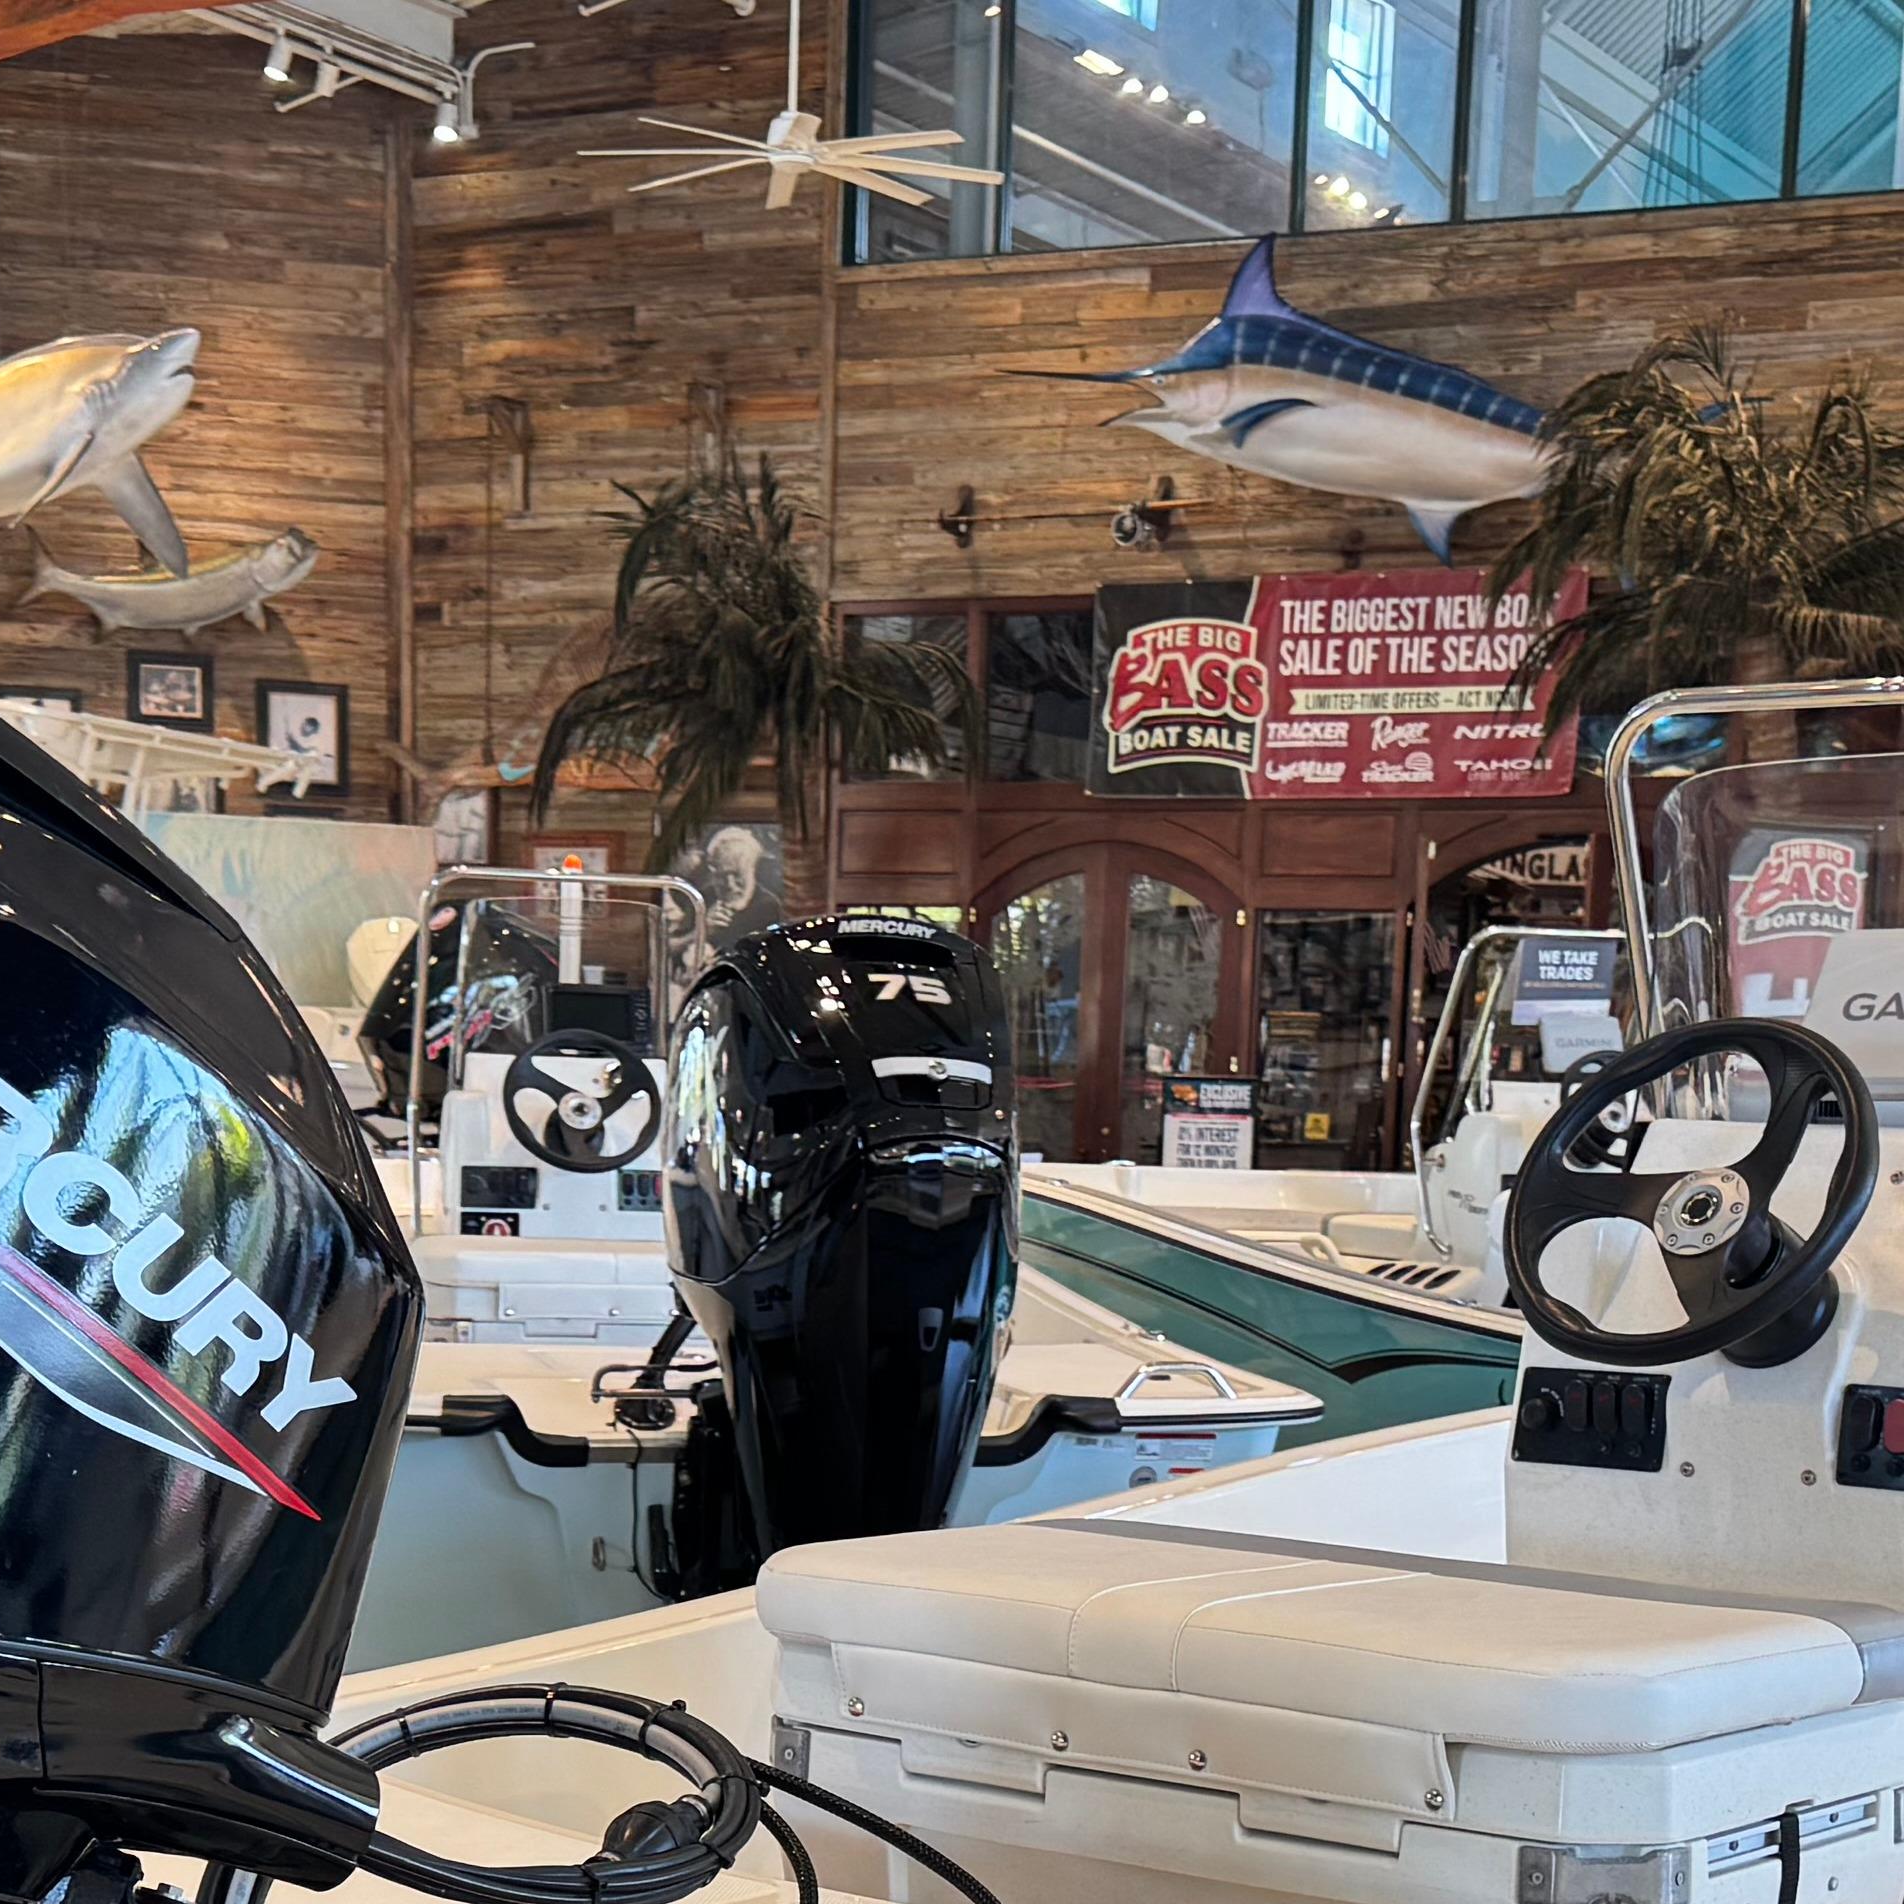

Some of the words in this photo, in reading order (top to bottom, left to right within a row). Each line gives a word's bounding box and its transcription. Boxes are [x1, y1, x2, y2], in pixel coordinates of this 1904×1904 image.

[1280, 600, 1327, 634] THE
[1330, 597, 1431, 633] BIGGEST
[1434, 594, 1490, 631] NEW
[1142, 627, 1191, 649] THE
[1199, 626, 1244, 653] BIG
[1279, 639, 1344, 676] SALE
[1348, 638, 1382, 675] OF
[1385, 637, 1439, 674] THE
[1109, 650, 1265, 733] BASS
[1391, 691, 1441, 710] OFFERS
[1456, 691, 1480, 708] ACT
[1118, 725, 1184, 754] BOAT
[1187, 726, 1253, 754] SALE
[1265, 721, 1350, 742] TRACKER
[1781, 843, 1813, 861] THE
[1815, 845, 1845, 863] BIG
[1743, 860, 1858, 919] BASS
[837, 918, 937, 939] MERCURY
[1753, 911, 1808, 932] BOAT
[1538, 949, 1560, 965] WE
[1563, 950, 1600, 966] TAKE
[1538, 966, 1594, 981] TRADES
[867, 973, 953, 1005] 75
[1555, 1037, 1613, 1049] GARMIN
